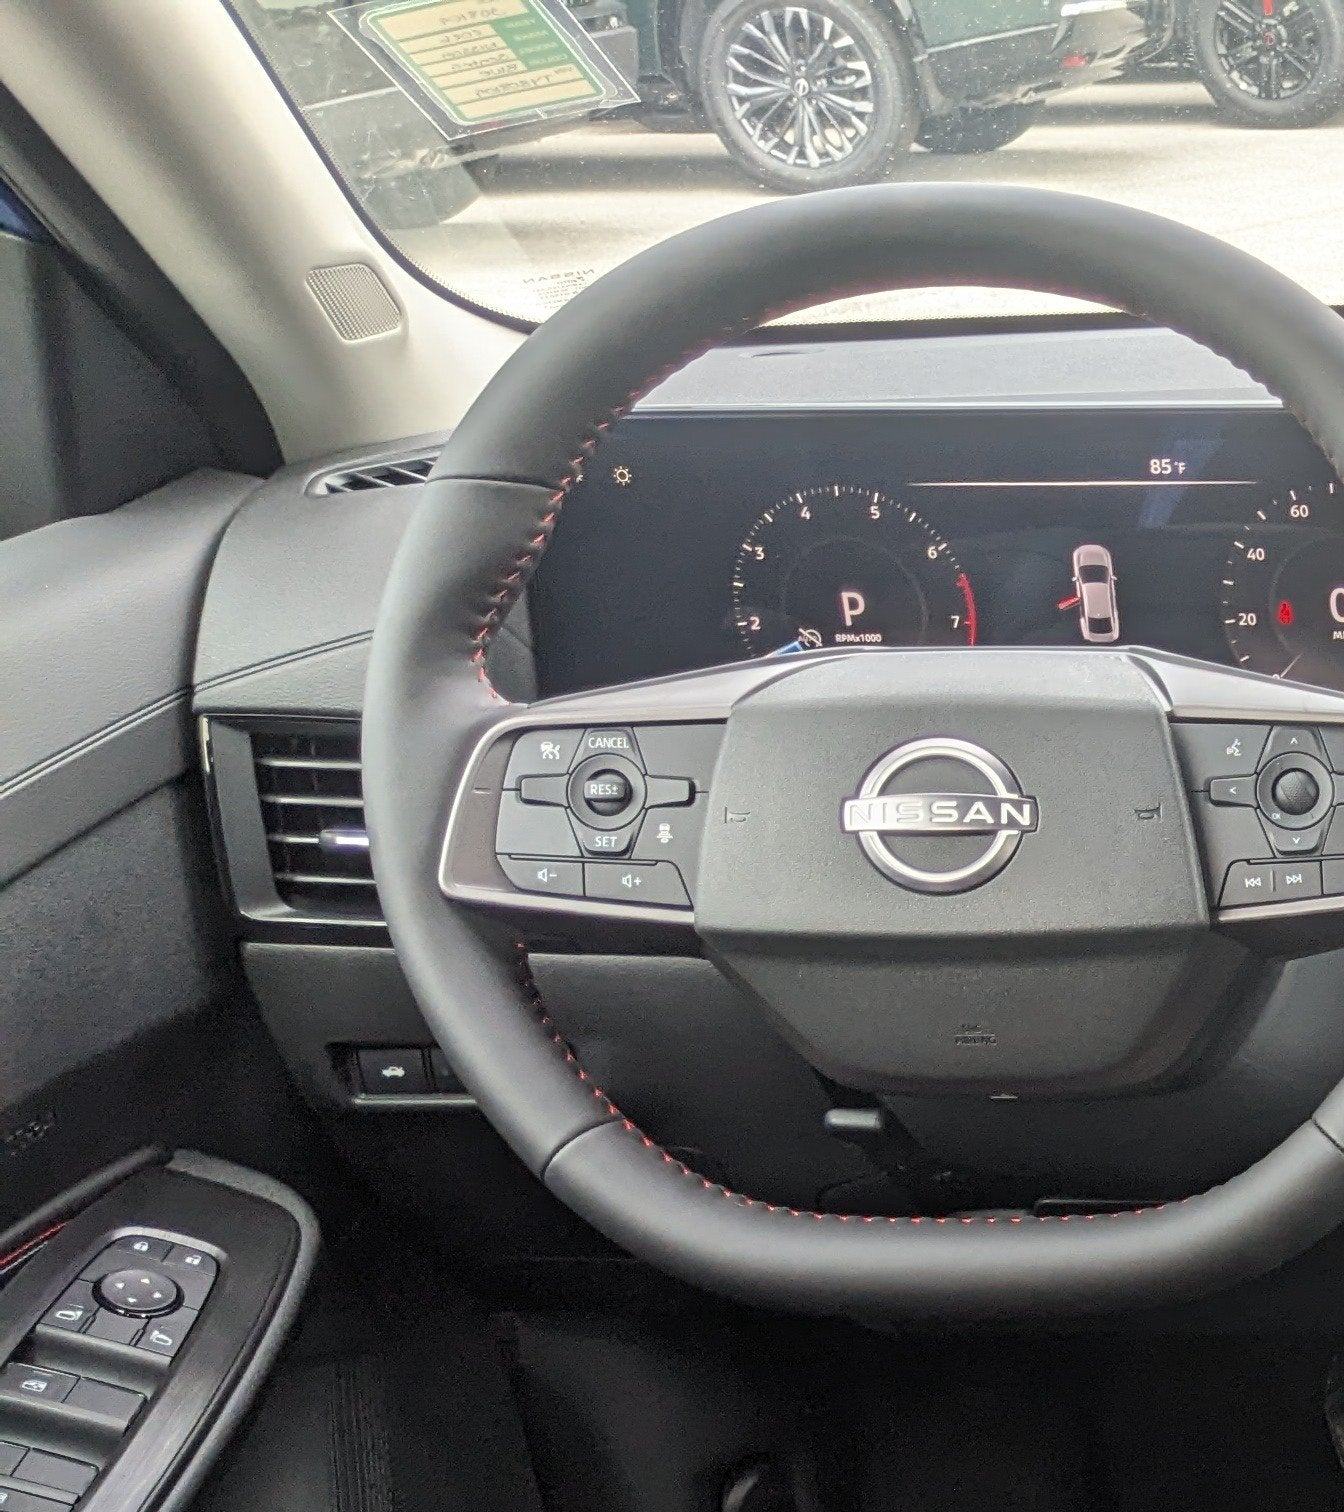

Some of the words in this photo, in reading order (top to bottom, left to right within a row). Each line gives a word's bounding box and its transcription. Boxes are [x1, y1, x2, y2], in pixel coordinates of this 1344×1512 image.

[800, 506, 811, 520] 4
[870, 505, 880, 520] 5
[1290, 504, 1309, 518] 60
[754, 545, 765, 560] 3
[927, 545, 938, 560] 6
[1247, 547, 1265, 561] 40
[840, 590, 866, 627] P
[749, 616, 761, 631] 2
[950, 615, 960, 629] 7
[1238, 613, 1257, 627] 20
[588, 737, 629, 748] CANCEL
[849, 800, 1031, 826] NISSAN
[595, 836, 617, 847] SET
